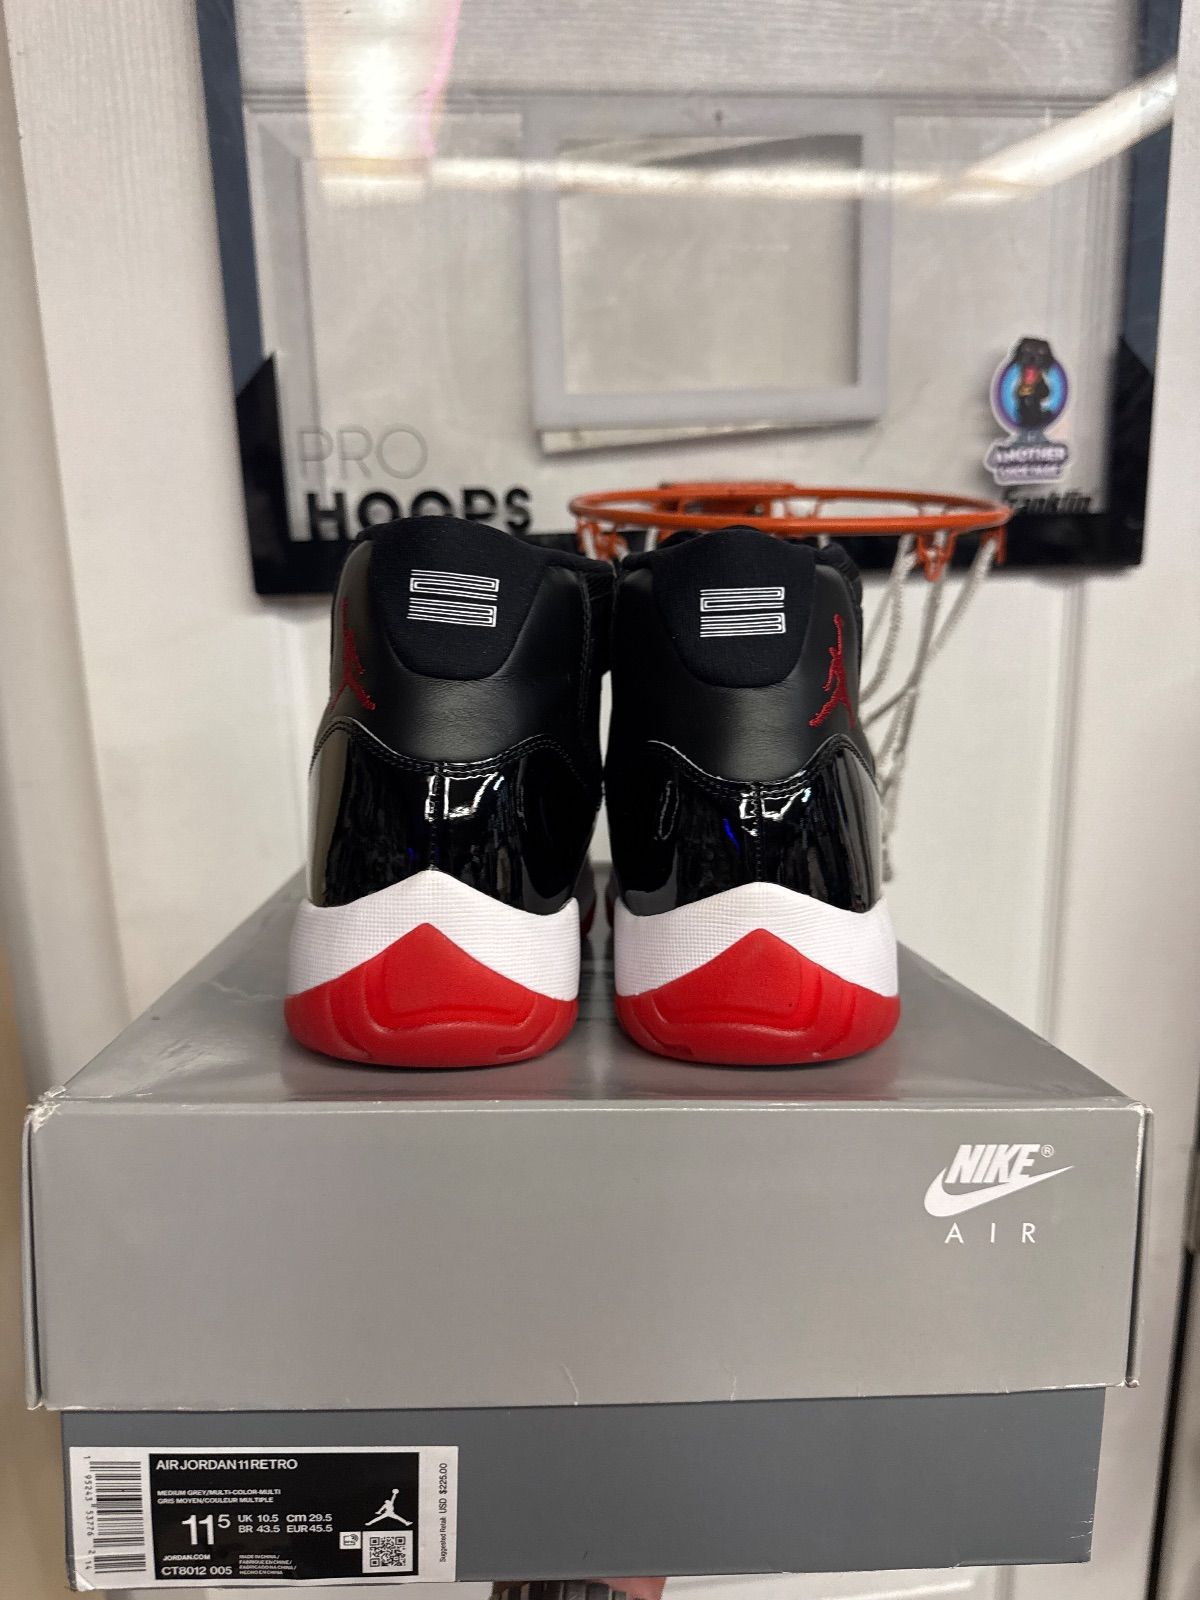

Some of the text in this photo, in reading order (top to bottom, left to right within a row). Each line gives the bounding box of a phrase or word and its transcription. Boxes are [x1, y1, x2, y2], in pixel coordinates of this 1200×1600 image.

[297, 423, 429, 480] PRO
[945, 1144, 1041, 1184] NIKE
[944, 1222, 1036, 1244] AIR
[156, 1459, 298, 1470] AIR JORDAN 11 RETRO
[439, 1463, 448, 1495] $225.00
[439, 1498, 447, 1514] USD
[237, 1514, 253, 1522] UK
[257, 1514, 279, 1522] 10.5
[308, 1513, 333, 1522] 29.5
[238, 1524, 333, 1533] BR 43.5 EUR 45.5
[439, 1534, 448, 1563] Suggested
[161, 1565, 233, 1576] CT8012 005
